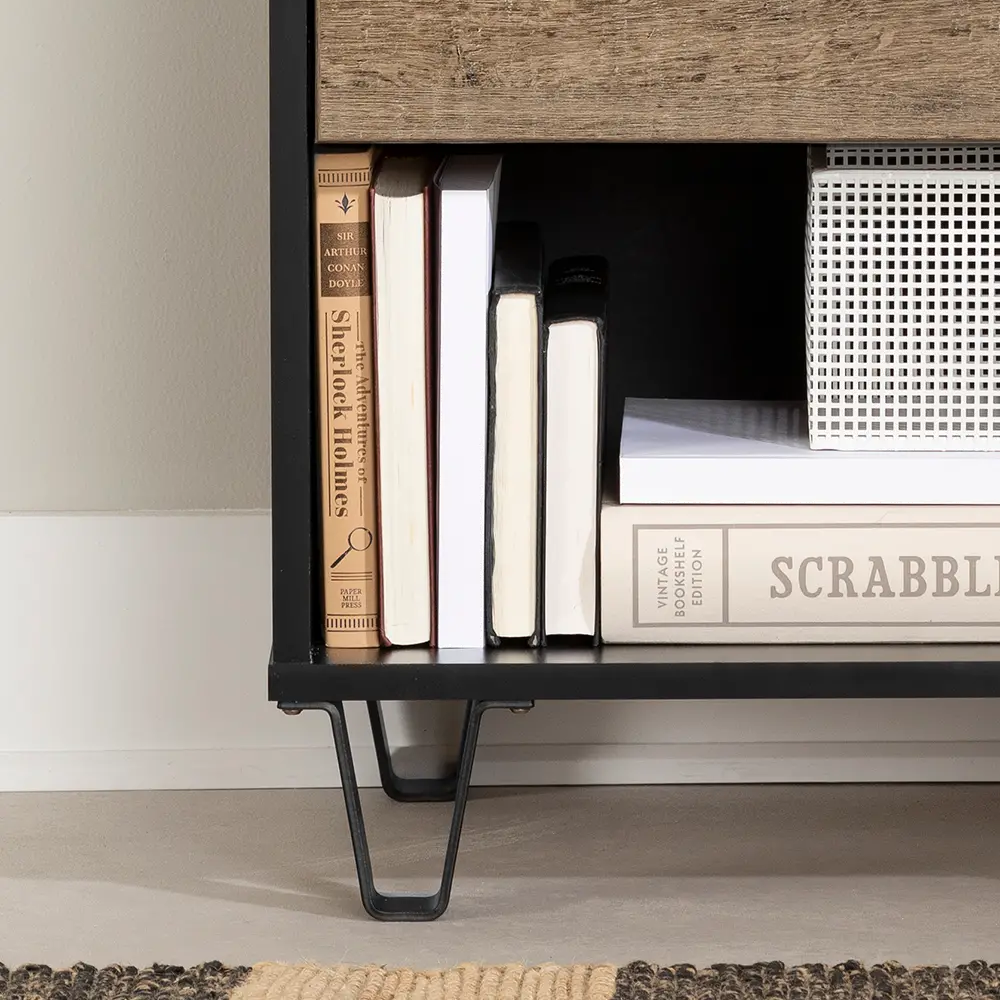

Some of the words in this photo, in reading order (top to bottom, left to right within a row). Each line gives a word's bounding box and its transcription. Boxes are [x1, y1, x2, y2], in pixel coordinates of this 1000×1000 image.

[324, 248, 367, 256] ARTHUR
[327, 263, 364, 272] CONAN
[329, 280, 364, 288] DOYLE
[331, 310, 352, 420] Sherlock
[356, 341, 366, 371] The
[355, 375, 371, 464] Adventures
[334, 428, 354, 518] Holmes
[357, 468, 367, 484] of
[657, 547, 668, 609] VINTAGE
[674, 536, 686, 617] BOOKSHELF
[692, 549, 702, 606] EDITION
